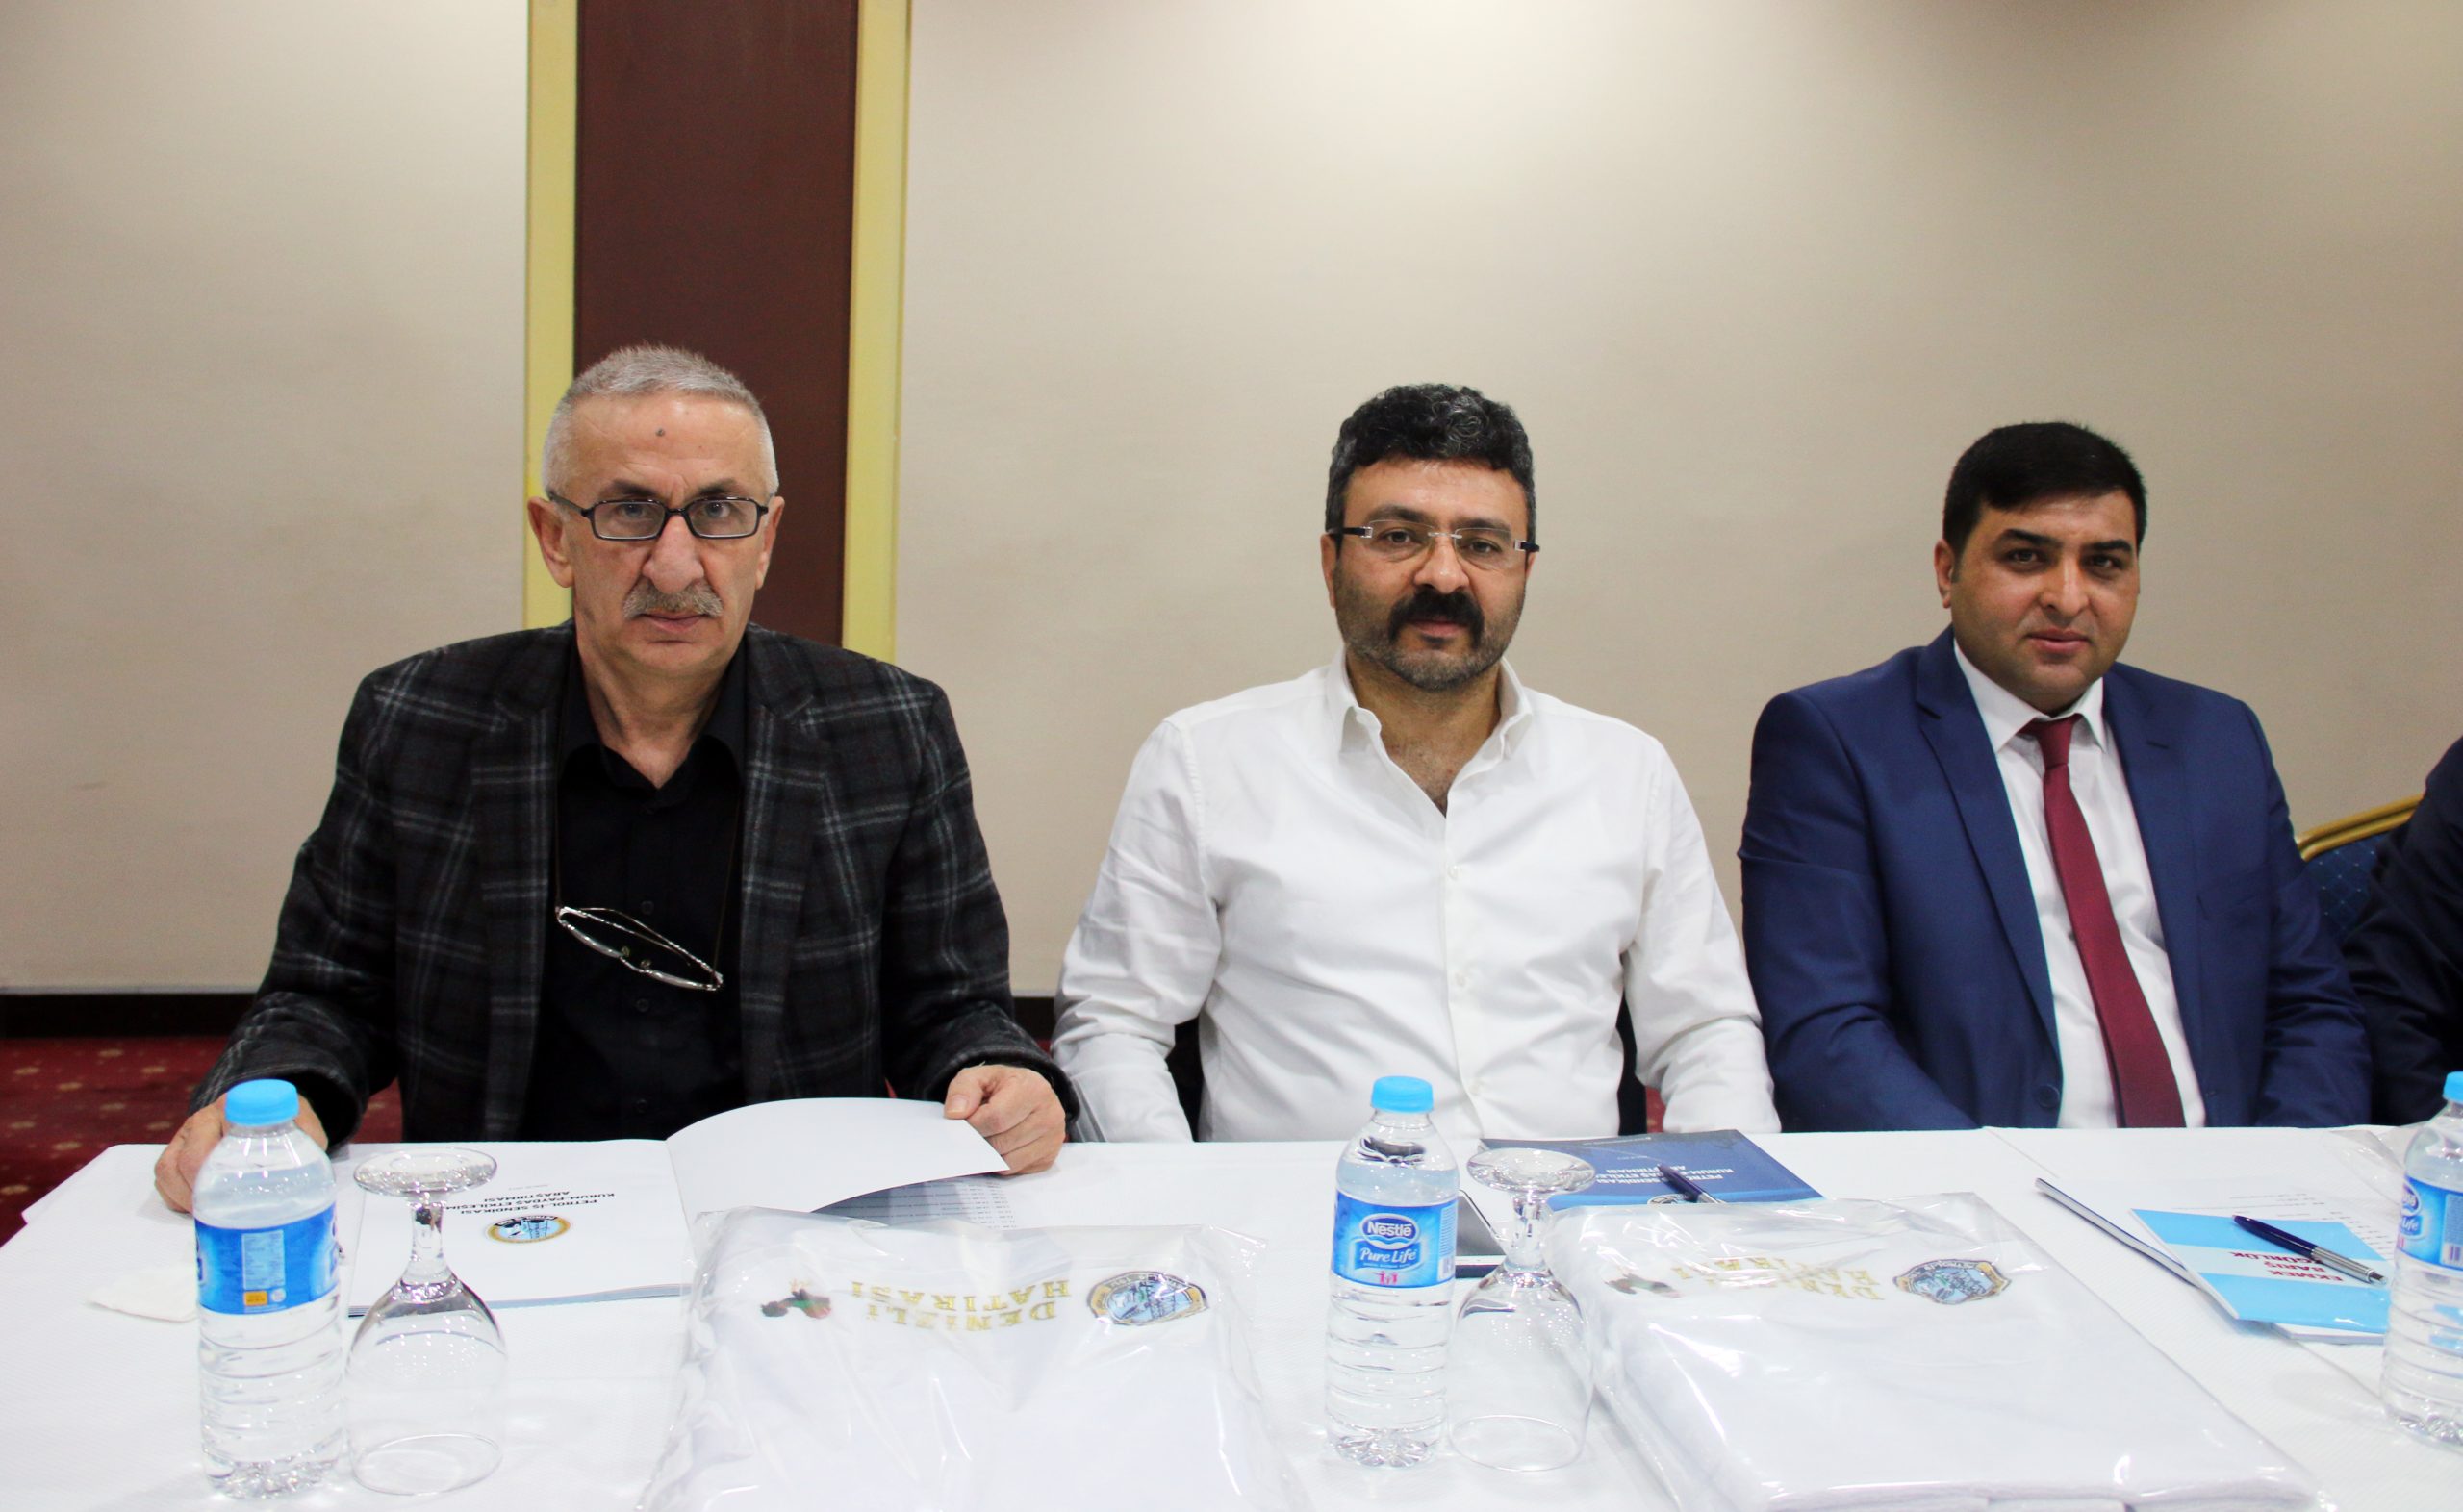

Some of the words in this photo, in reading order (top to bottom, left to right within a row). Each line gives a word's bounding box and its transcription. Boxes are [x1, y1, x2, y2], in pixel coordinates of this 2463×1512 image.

[483, 1191, 570, 1202] ARAŞTIRMASI
[459, 1205, 529, 1214] SENDİKASI
[1367, 1221, 1412, 1237] Nestlé
[1359, 1247, 1390, 1263] Pure
[1391, 1247, 1416, 1264] Life
[2266, 1270, 2344, 1282] EKMEK
[849, 1280, 1072, 1312] HATIRASI
